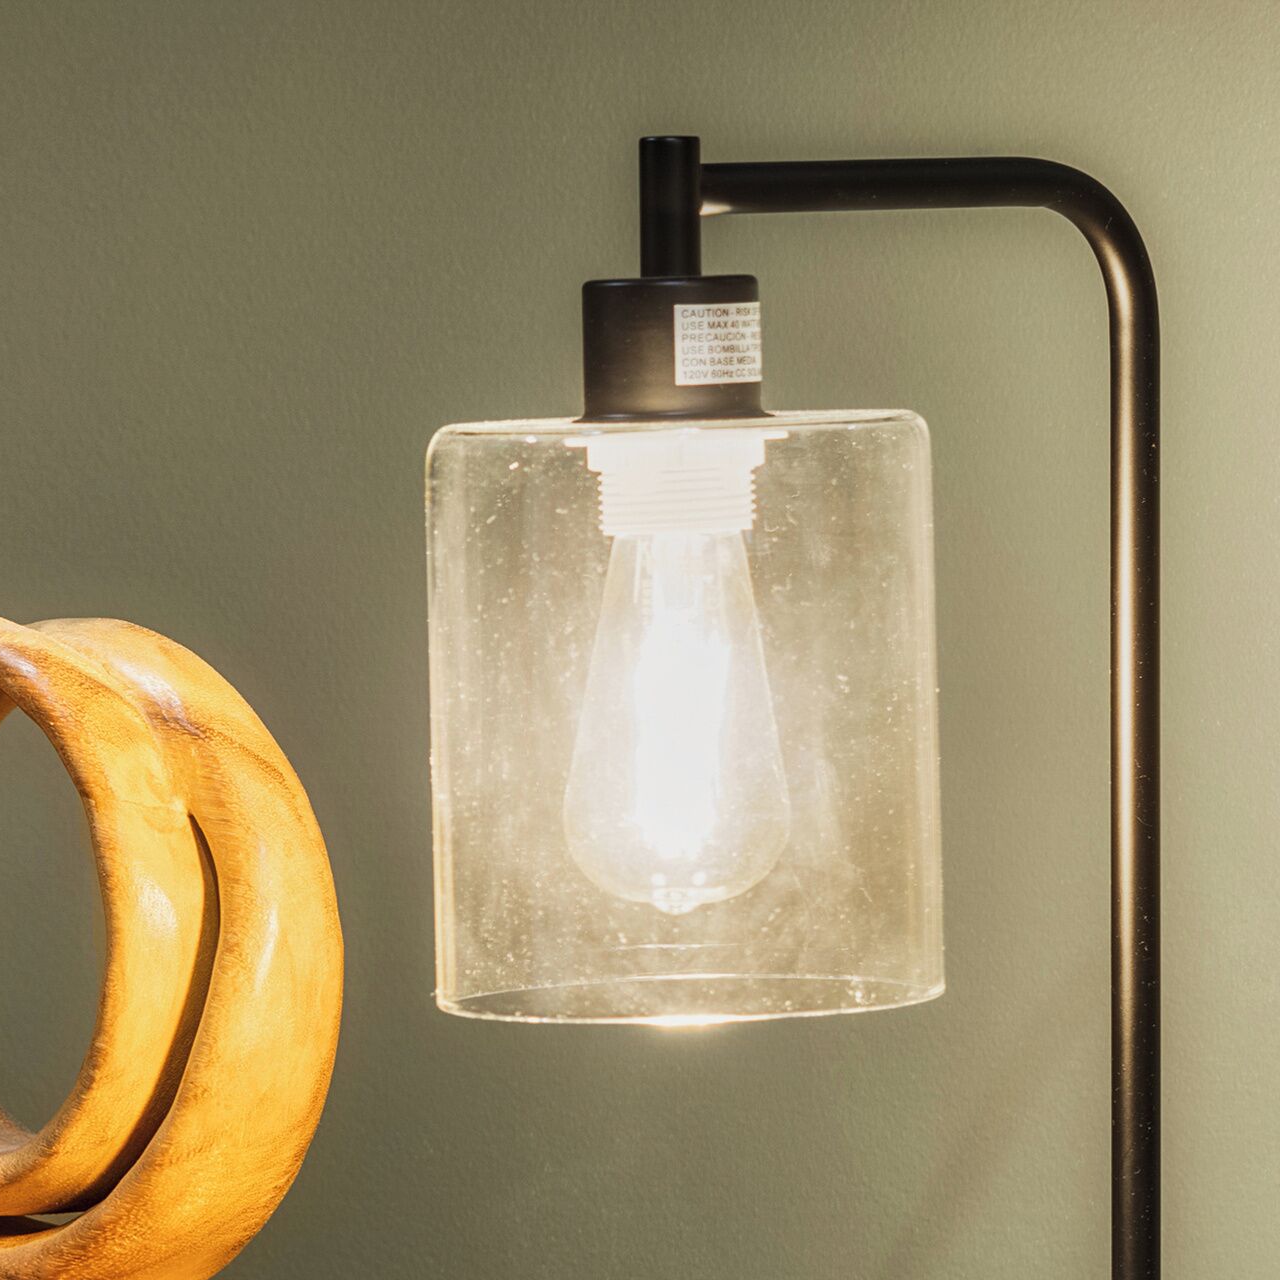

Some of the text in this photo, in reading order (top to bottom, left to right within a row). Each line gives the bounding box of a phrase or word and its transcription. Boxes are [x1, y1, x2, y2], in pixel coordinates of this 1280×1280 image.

[681, 308, 729, 319] CAUTION
[681, 321, 704, 331] USE
[707, 320, 728, 329] MAX
[682, 345, 704, 356] USE
[708, 344, 750, 354] BOMBILLA
[682, 358, 707, 368] CON
[709, 356, 735, 367] BASE
[683, 370, 709, 380] 120V
[711, 369, 734, 379] 60Hz
